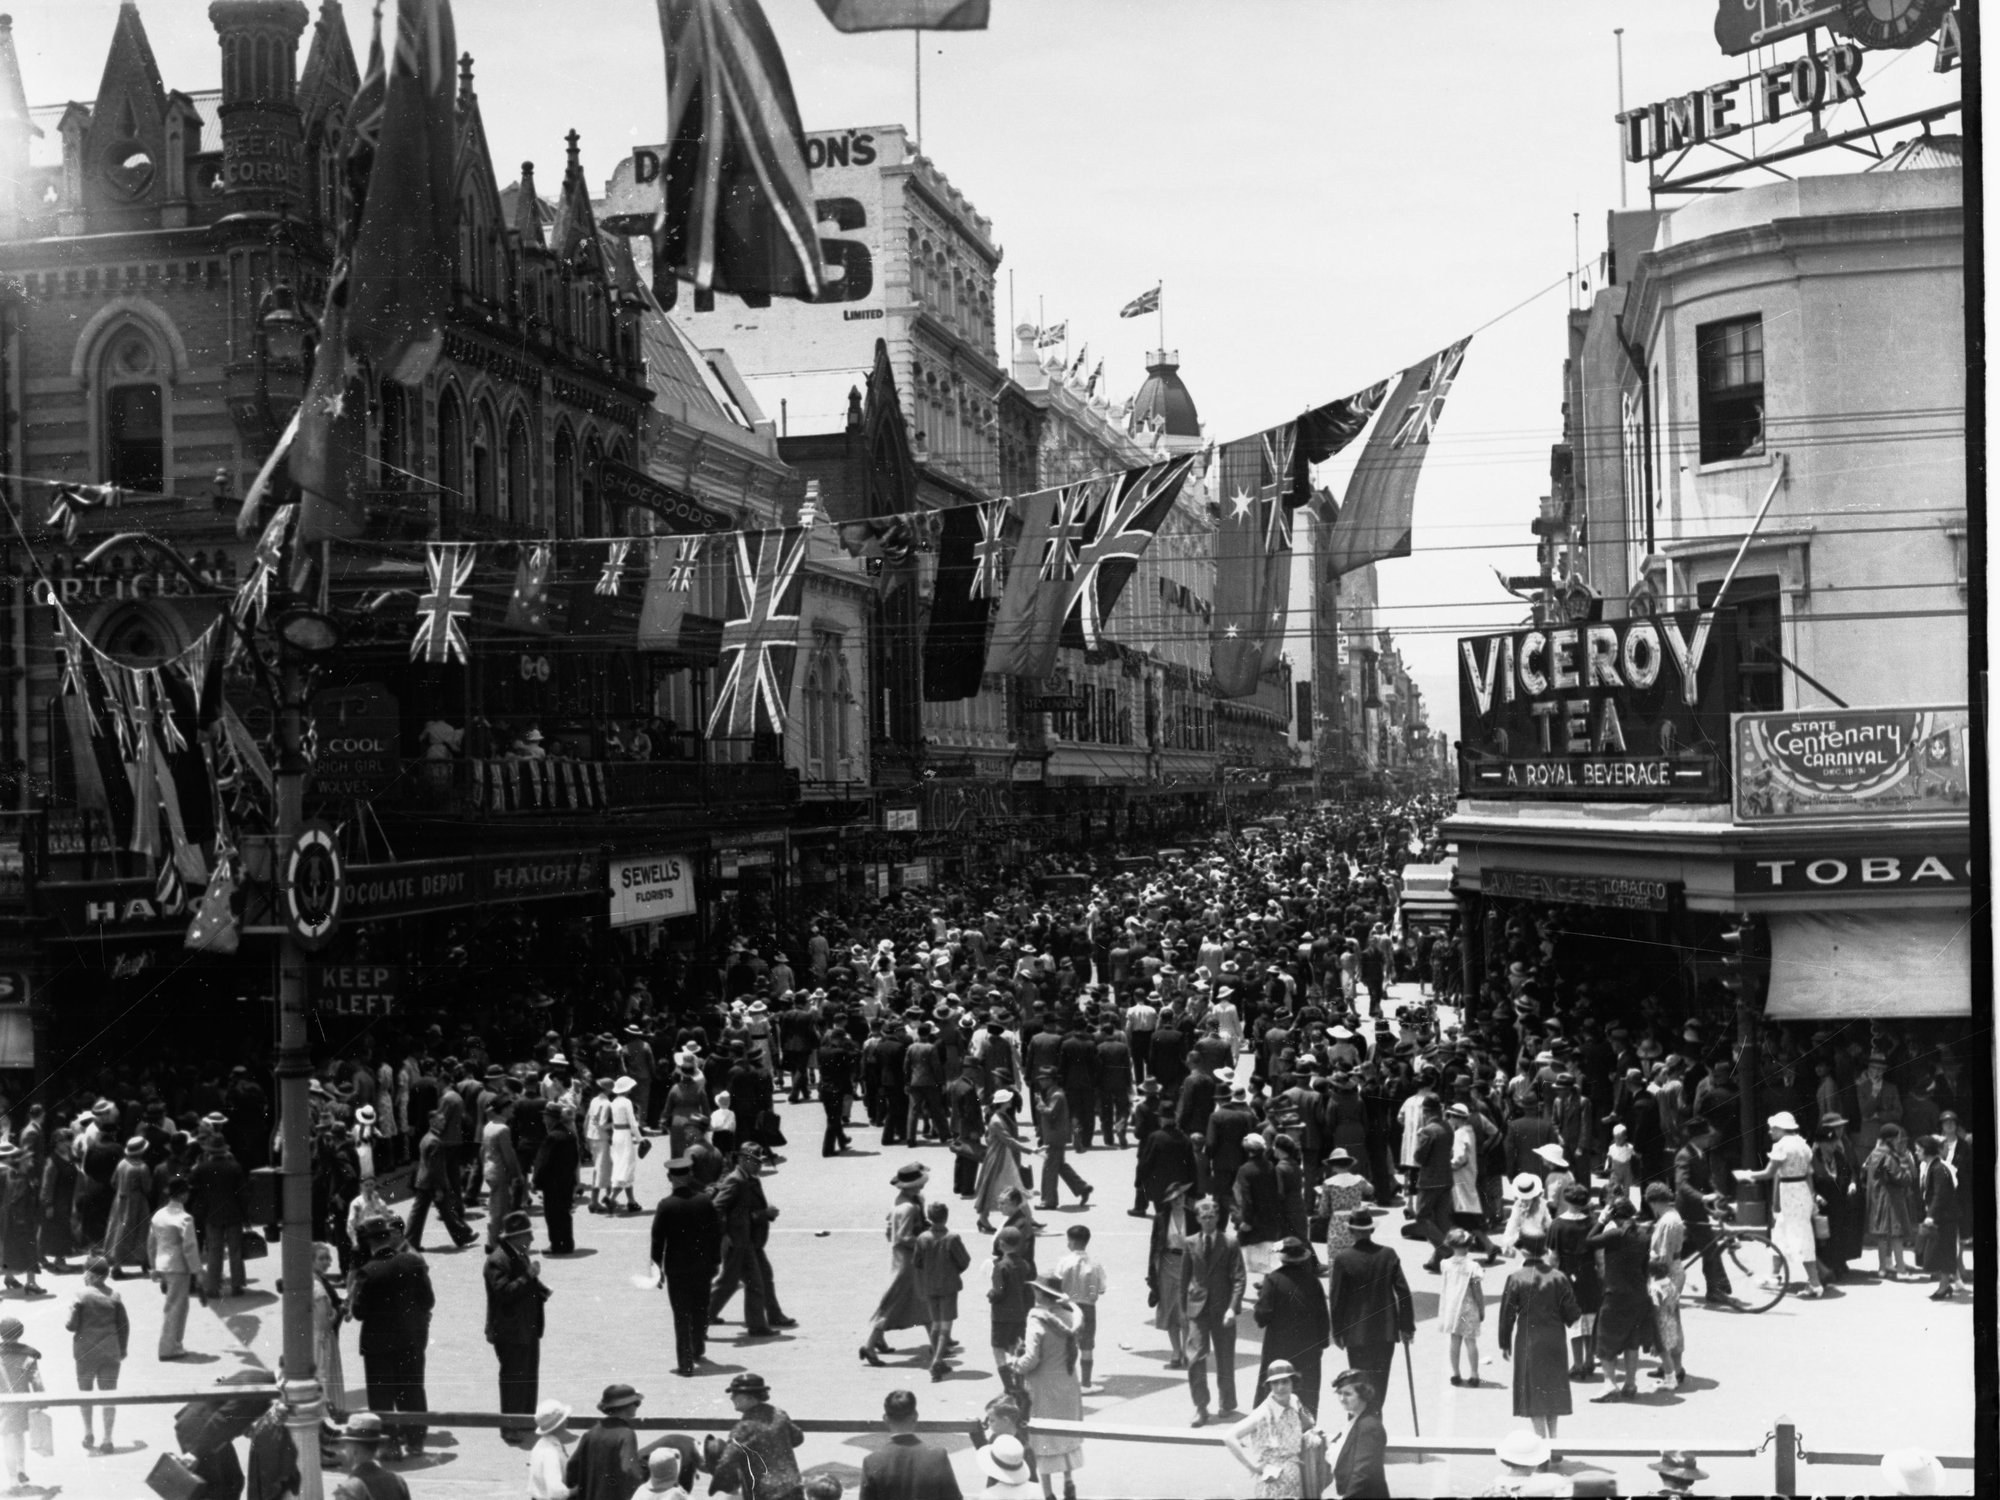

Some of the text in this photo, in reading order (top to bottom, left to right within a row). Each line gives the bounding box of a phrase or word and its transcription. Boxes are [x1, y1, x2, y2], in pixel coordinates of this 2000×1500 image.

[1615, 80, 1740, 163] TIME
[1760, 42, 1867, 124] FOR
[843, 309, 883, 321] LIMITED
[1461, 611, 1716, 716] VICEROY
[1531, 697, 1627, 752] TEA
[1791, 720, 1837, 732] STATE
[329, 738, 385, 753] COOL
[1773, 723, 1901, 756] Centenary
[354, 759, 384, 774] GIRL
[1803, 750, 1888, 767] CARNIVAL
[1507, 764, 1518, 785] A
[1527, 763, 1577, 785] ROYAL
[621, 861, 681, 888] SEWELL'S
[1756, 856, 1971, 885] TOBA
[344, 872, 466, 904] OCOLATE DEPOT
[635, 888, 674, 903] FLORISTS
[322, 967, 390, 988] KEEP
[317, 994, 395, 1016] TO LEFT
